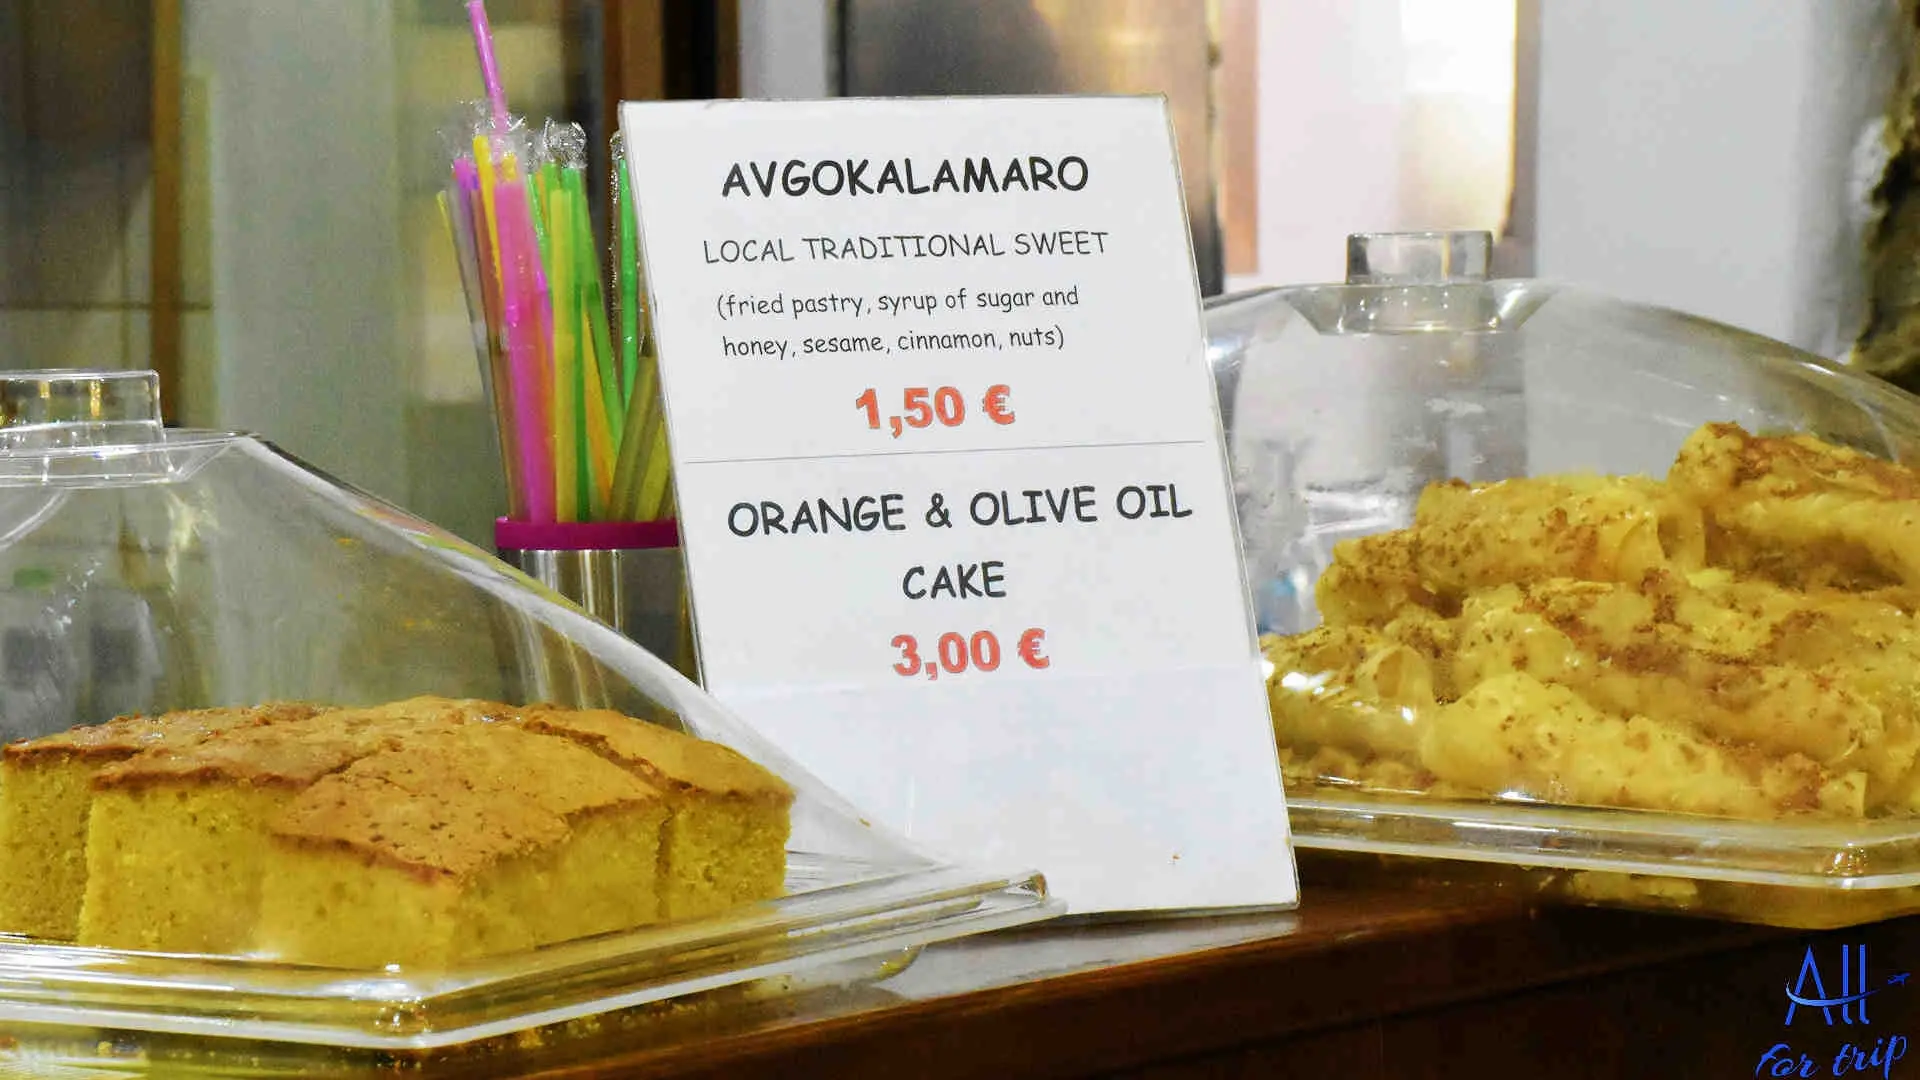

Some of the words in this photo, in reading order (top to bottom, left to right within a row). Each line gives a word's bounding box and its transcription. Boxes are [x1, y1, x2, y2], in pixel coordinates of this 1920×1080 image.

[721, 155, 1089, 199] AVGOKALAMARO
[703, 237, 795, 265] LOCAL
[800, 232, 1006, 261] TRADITIONAL
[1014, 230, 1109, 256] SWEET
[716, 292, 785, 321] (fried
[791, 292, 872, 321] pastry,
[877, 294, 938, 317] syrup
[943, 287, 968, 310] of
[975, 291, 1036, 314] sugar
[1042, 284, 1079, 306] and
[722, 335, 796, 361] honey,
[802, 335, 891, 355] sesame,
[897, 330, 1003, 353] cinnamon,
[1008, 323, 1065, 351] nuts)
[855, 385, 966, 440] 1,50
[981, 383, 1016, 426] €
[727, 493, 907, 538] ORANGE
[924, 492, 953, 529] &
[969, 485, 1099, 527] OLIVE
[1115, 482, 1193, 520] OIL
[902, 560, 1008, 601] CAKE
[890, 629, 1001, 681] 3,00
[1016, 627, 1050, 670] €
